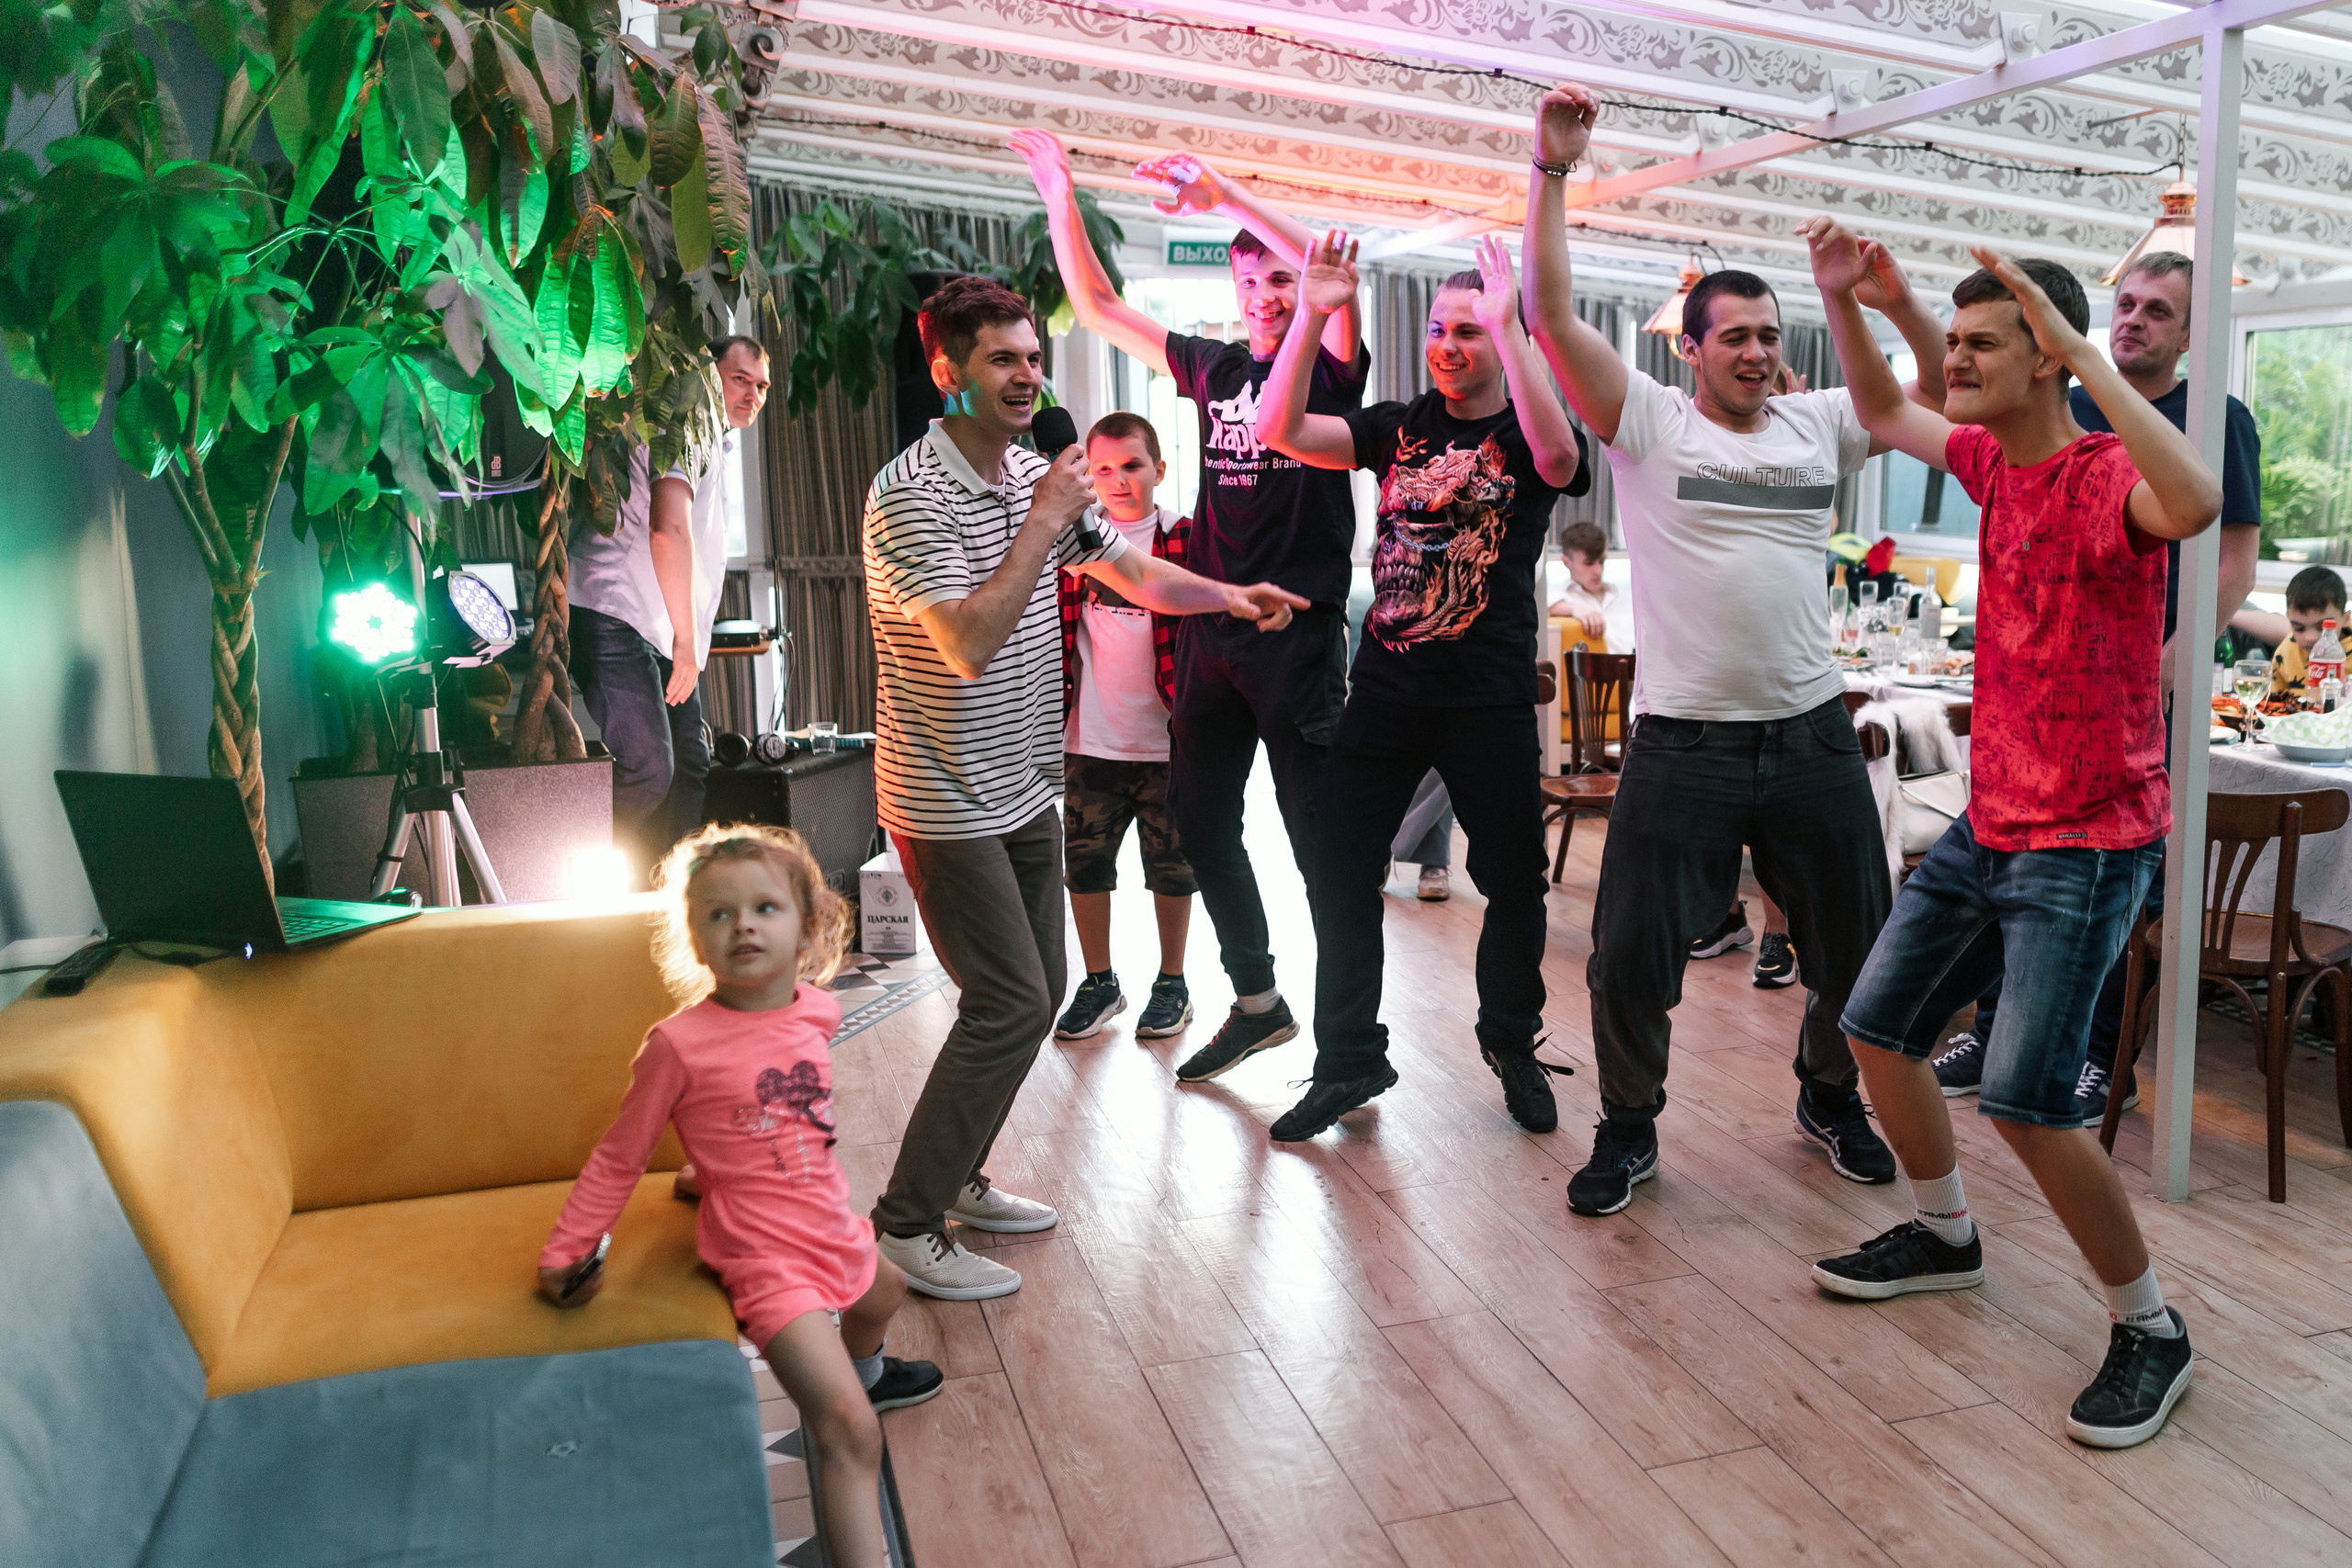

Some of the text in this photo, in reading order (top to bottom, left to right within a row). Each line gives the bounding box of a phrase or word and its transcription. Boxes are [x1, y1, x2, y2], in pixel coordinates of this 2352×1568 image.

[1173, 244, 1229, 262] ВЫХО
[1218, 473, 1258, 486] Since 1967
[1697, 461, 1826, 487] CULTURE
[867, 915, 909, 924] ЦАРСКАЯ
